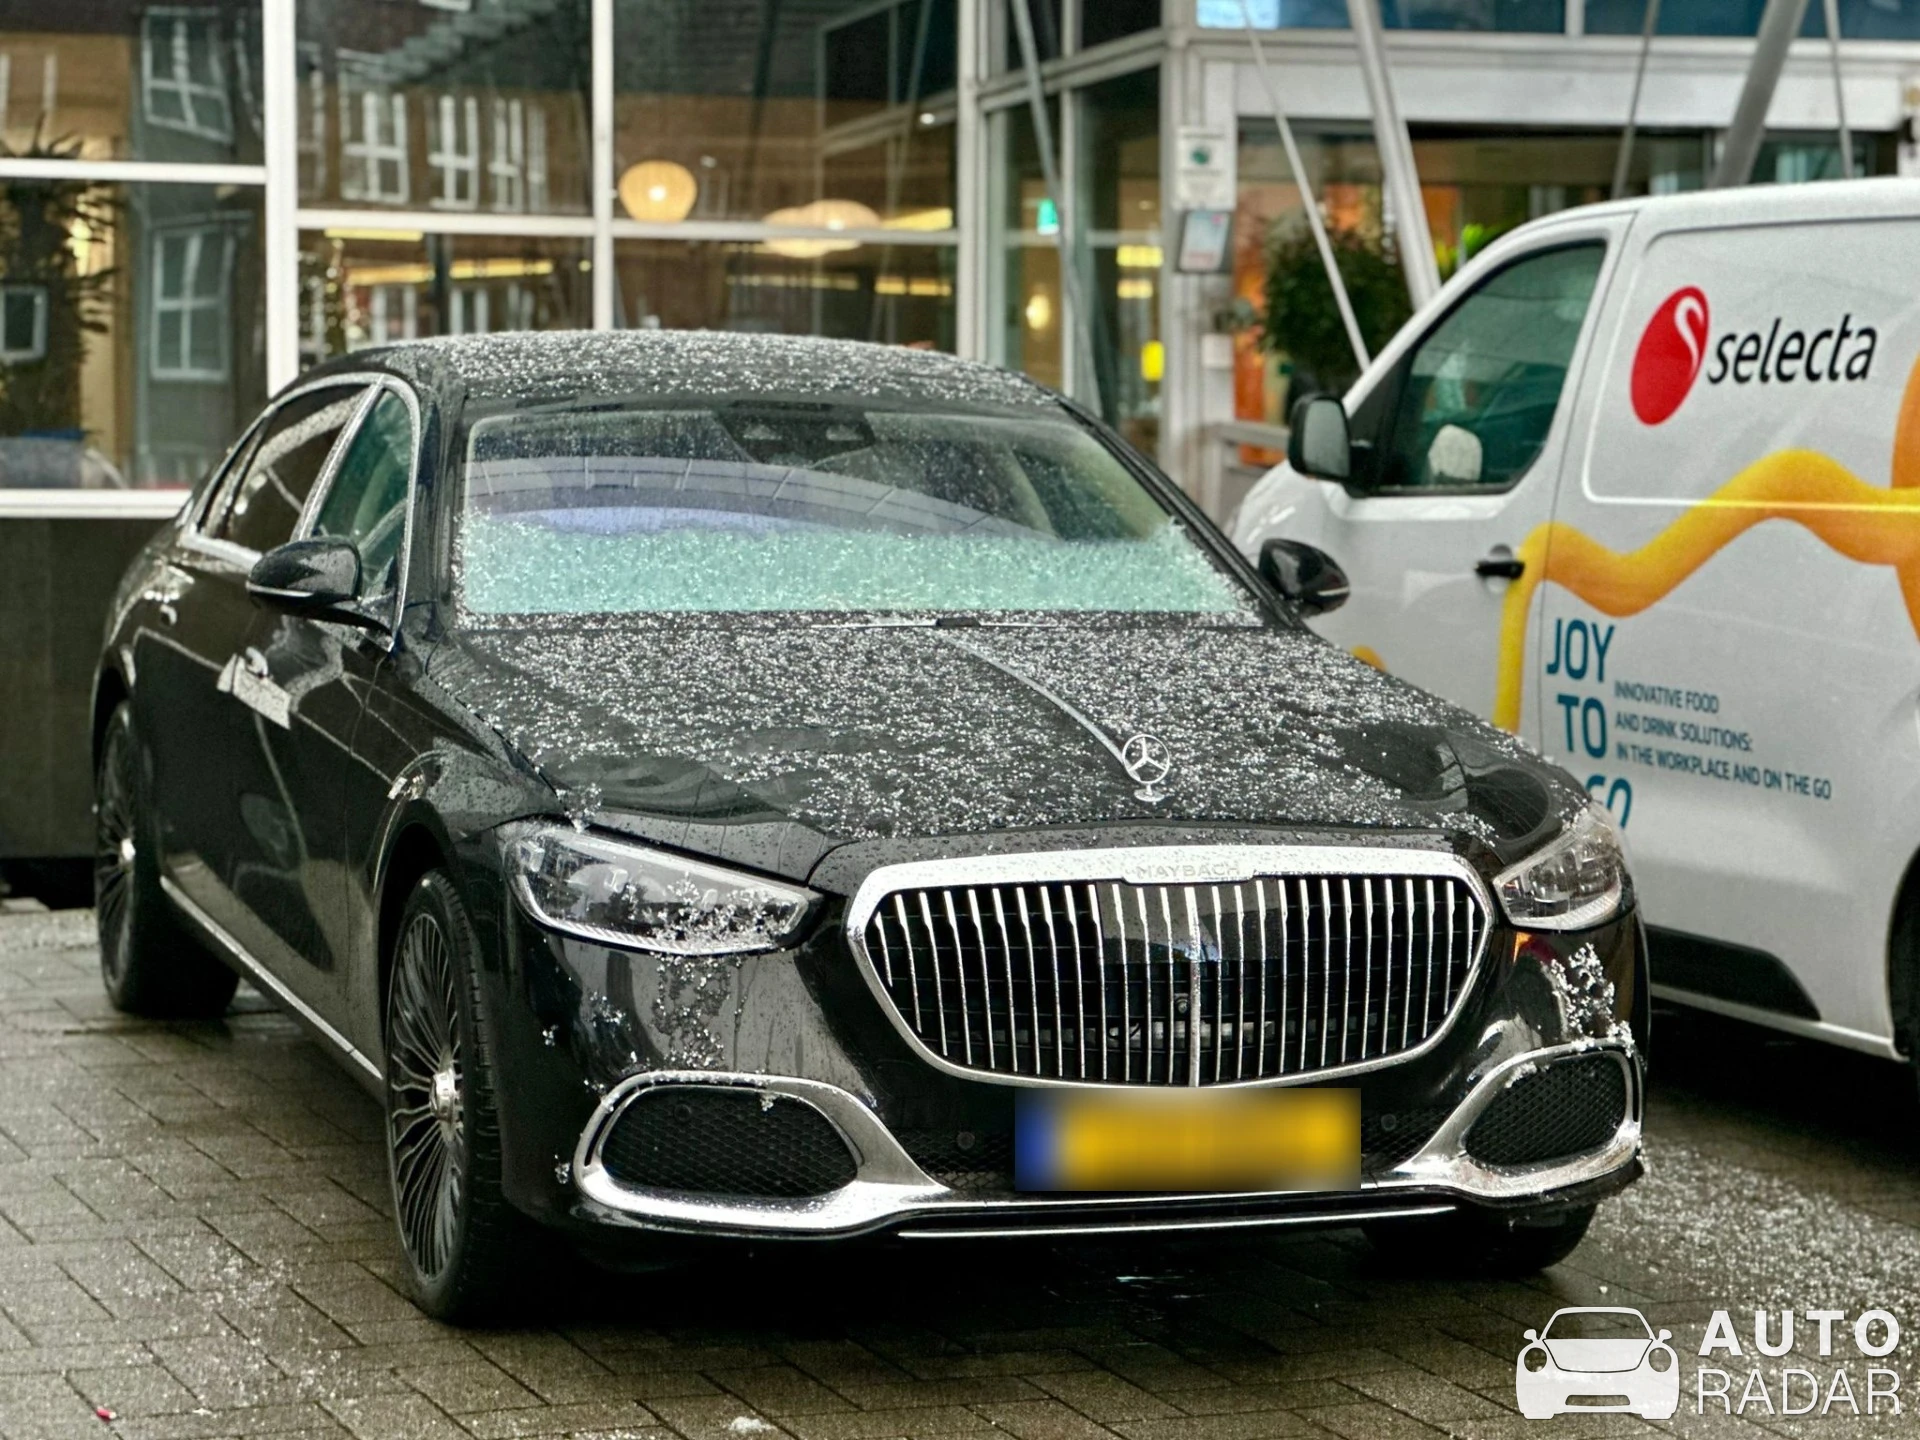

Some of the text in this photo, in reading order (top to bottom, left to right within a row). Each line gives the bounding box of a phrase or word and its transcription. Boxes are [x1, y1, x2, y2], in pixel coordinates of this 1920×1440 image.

[1707, 313, 1877, 384] selecta
[1546, 618, 1615, 683] JOY
[1557, 693, 1608, 759] TO
[1614, 680, 1719, 714] INNOVATIVE FOOD
[1615, 711, 1639, 732] AND
[1642, 716, 1677, 738] DRINK
[1616, 742, 1832, 800] IN THE WORKPLACE AND ON THE GO
[1136, 862, 1240, 879] MAYBACH
